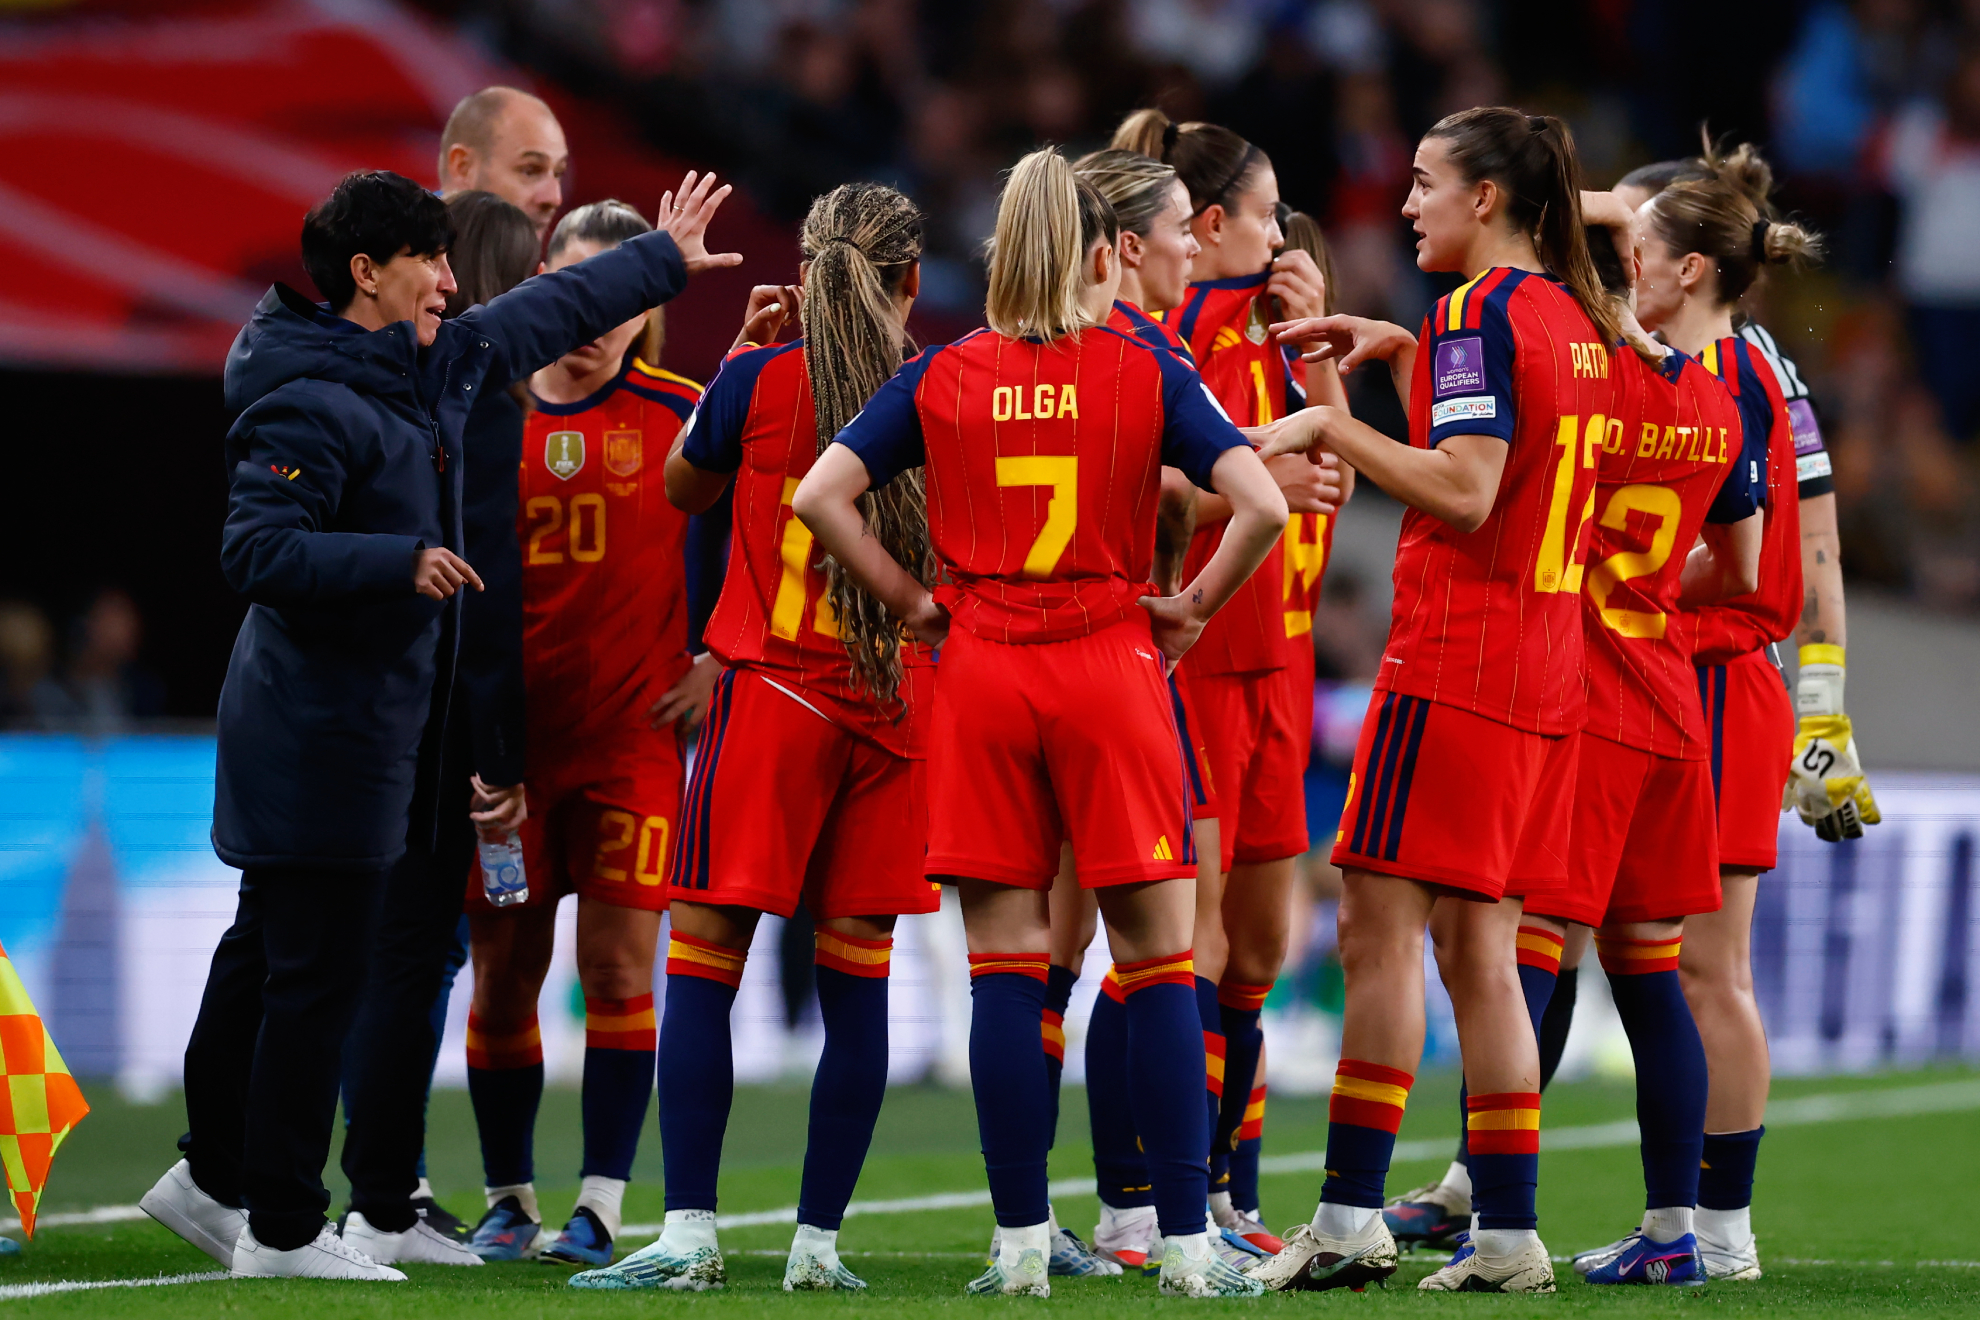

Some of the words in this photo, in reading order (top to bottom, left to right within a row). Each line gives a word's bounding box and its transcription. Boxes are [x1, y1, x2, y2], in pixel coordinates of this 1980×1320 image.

[1440, 371, 1479, 383] EUROPEAN
[1568, 342, 1609, 379] PATRI
[992, 384, 1079, 421] OLGA
[1439, 378, 1480, 390] QUALIFIERS
[1637, 422, 1729, 464] BATLLE
[526, 493, 606, 565] 20
[994, 455, 1079, 581] 7
[1587, 483, 1682, 640] 2
[595, 810, 669, 886] 20
